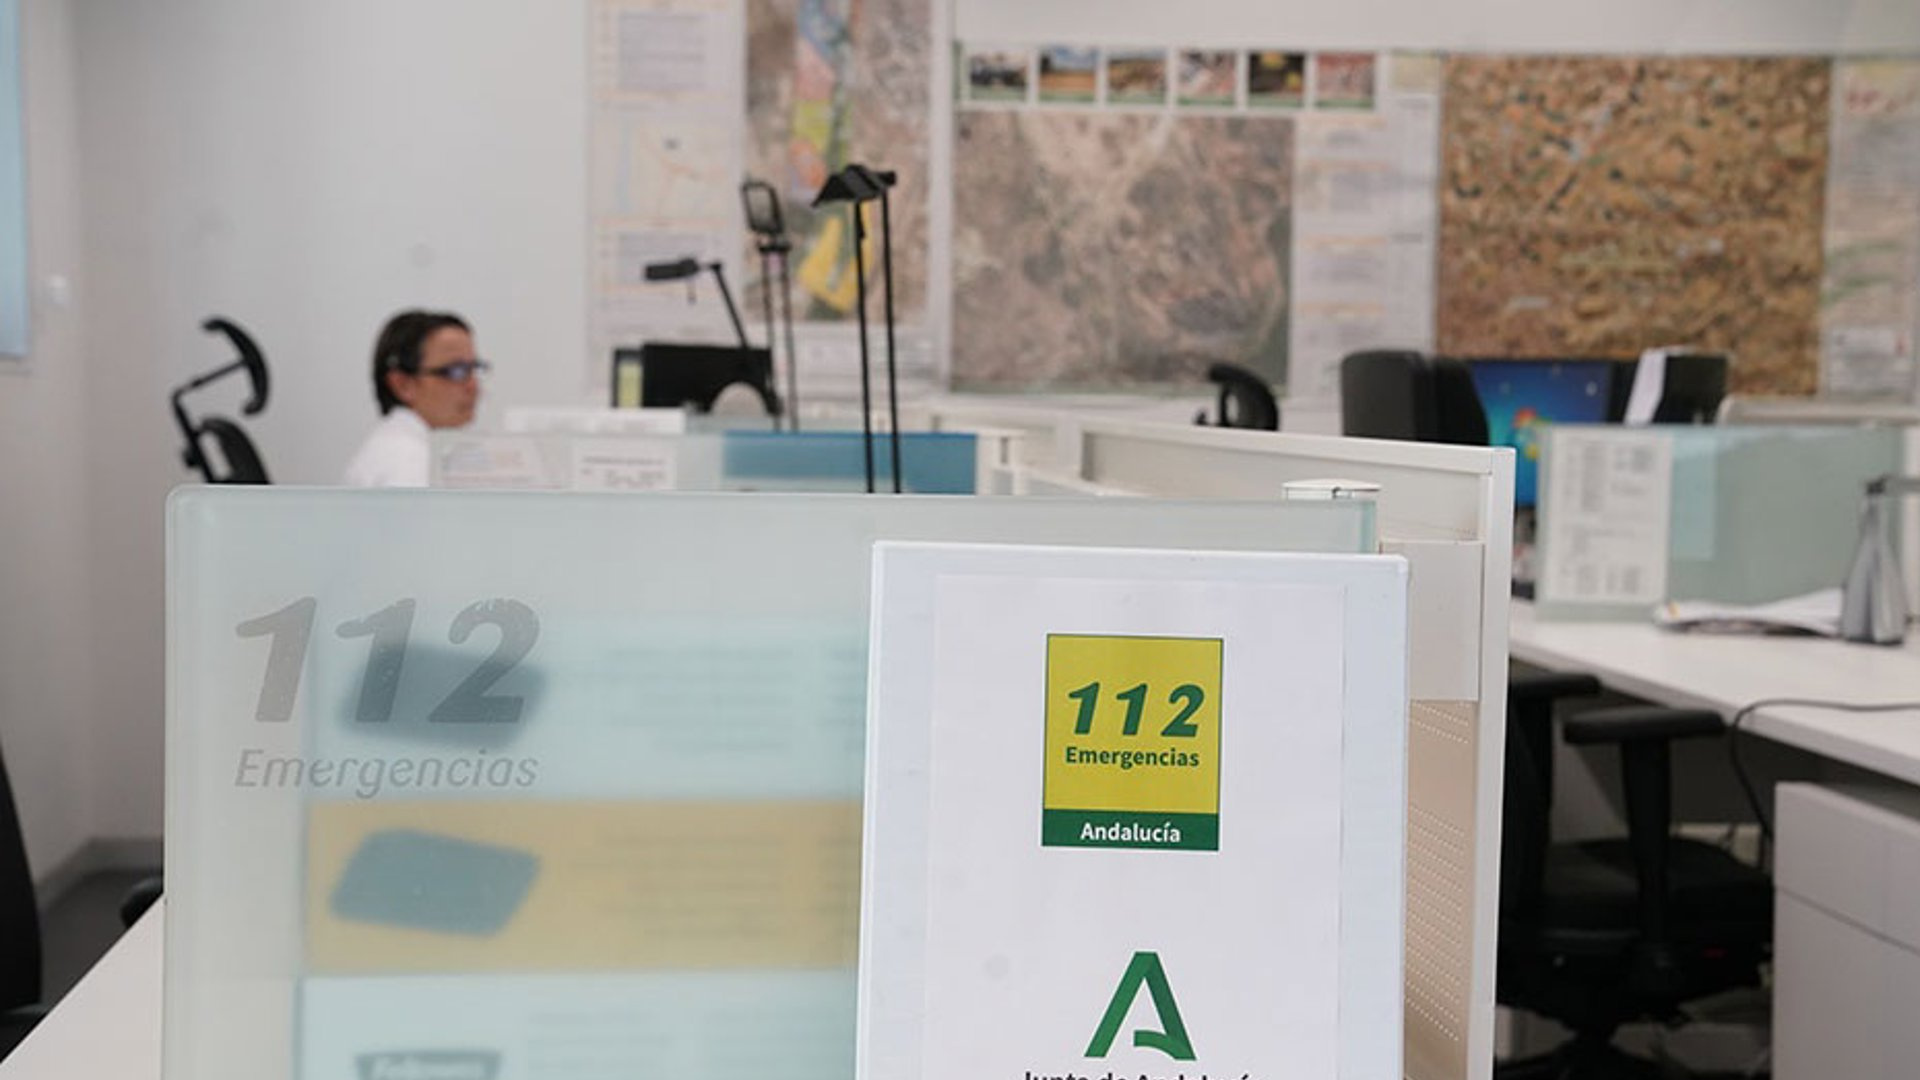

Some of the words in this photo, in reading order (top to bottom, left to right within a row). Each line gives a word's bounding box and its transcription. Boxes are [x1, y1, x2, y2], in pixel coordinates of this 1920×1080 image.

[235, 597, 540, 723] 112
[1068, 682, 1205, 737] 112
[234, 748, 539, 799] Emergencias
[1065, 746, 1200, 769] Emergencias
[1080, 822, 1181, 843] Andalucía
